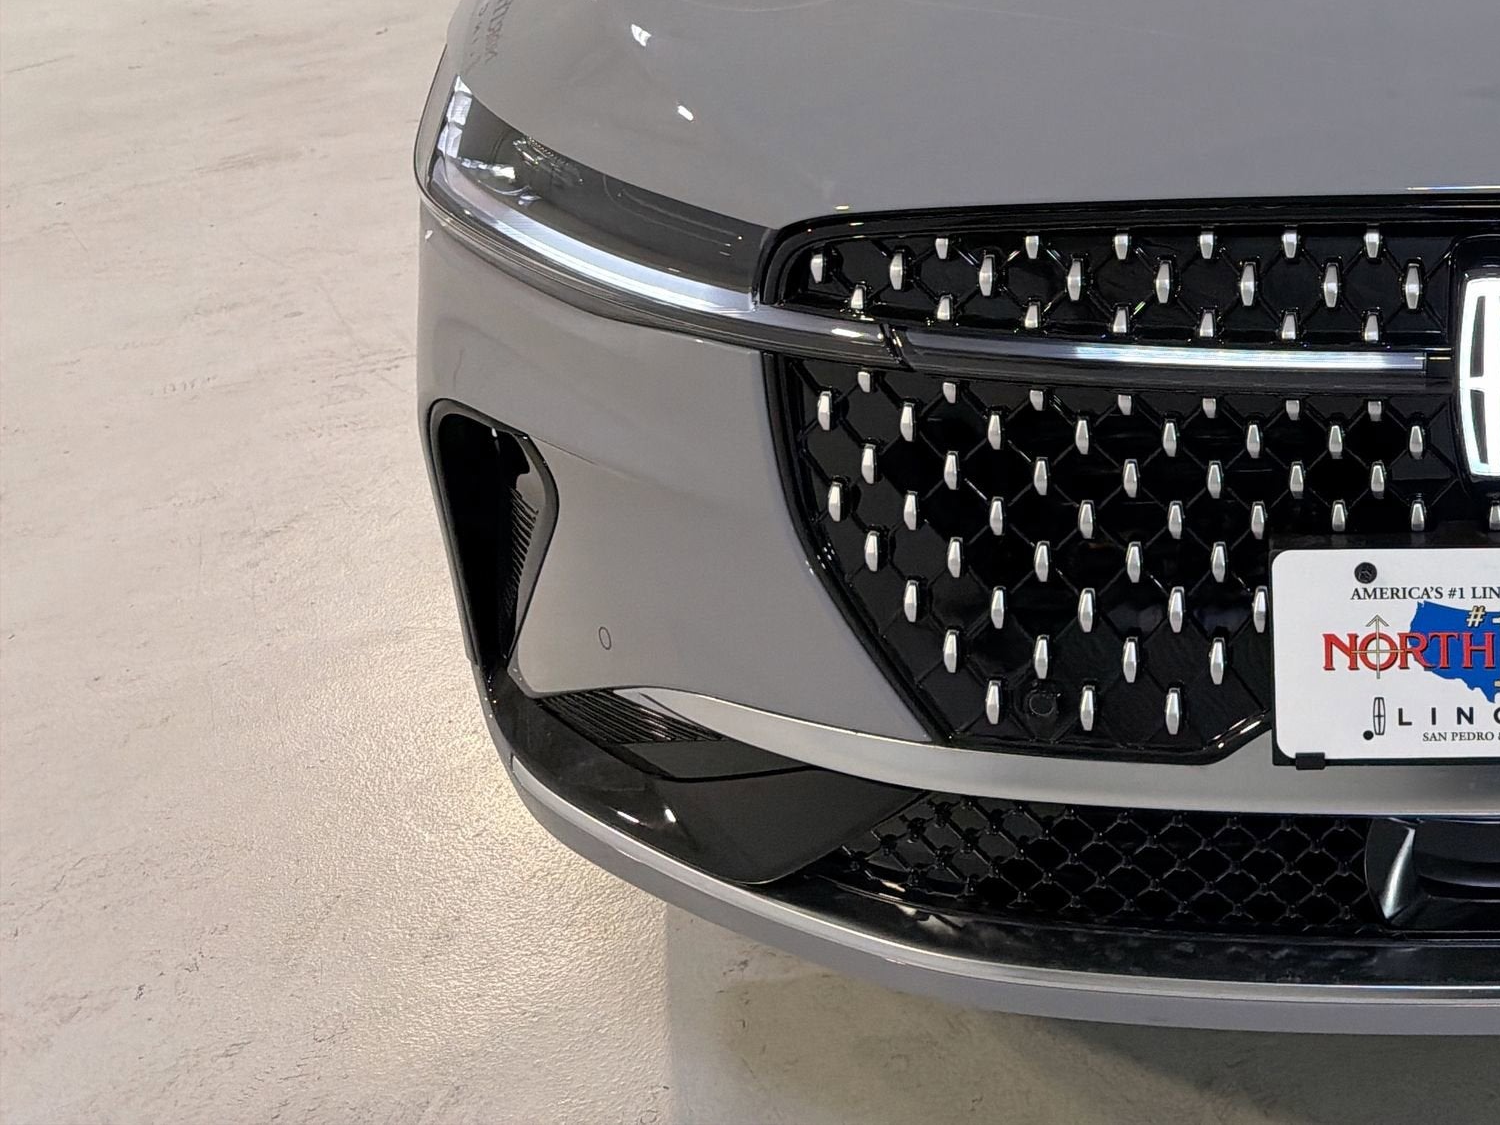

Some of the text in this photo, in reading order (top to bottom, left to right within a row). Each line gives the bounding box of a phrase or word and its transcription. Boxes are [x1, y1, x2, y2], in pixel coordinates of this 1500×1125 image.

[1350, 586, 1443, 600] AMERICA'S
[1448, 586, 1466, 600] #1
[1322, 631, 1496, 671] NORTH
[1422, 732, 1447, 742] SAN
[1451, 731, 1495, 742] PEDRO
